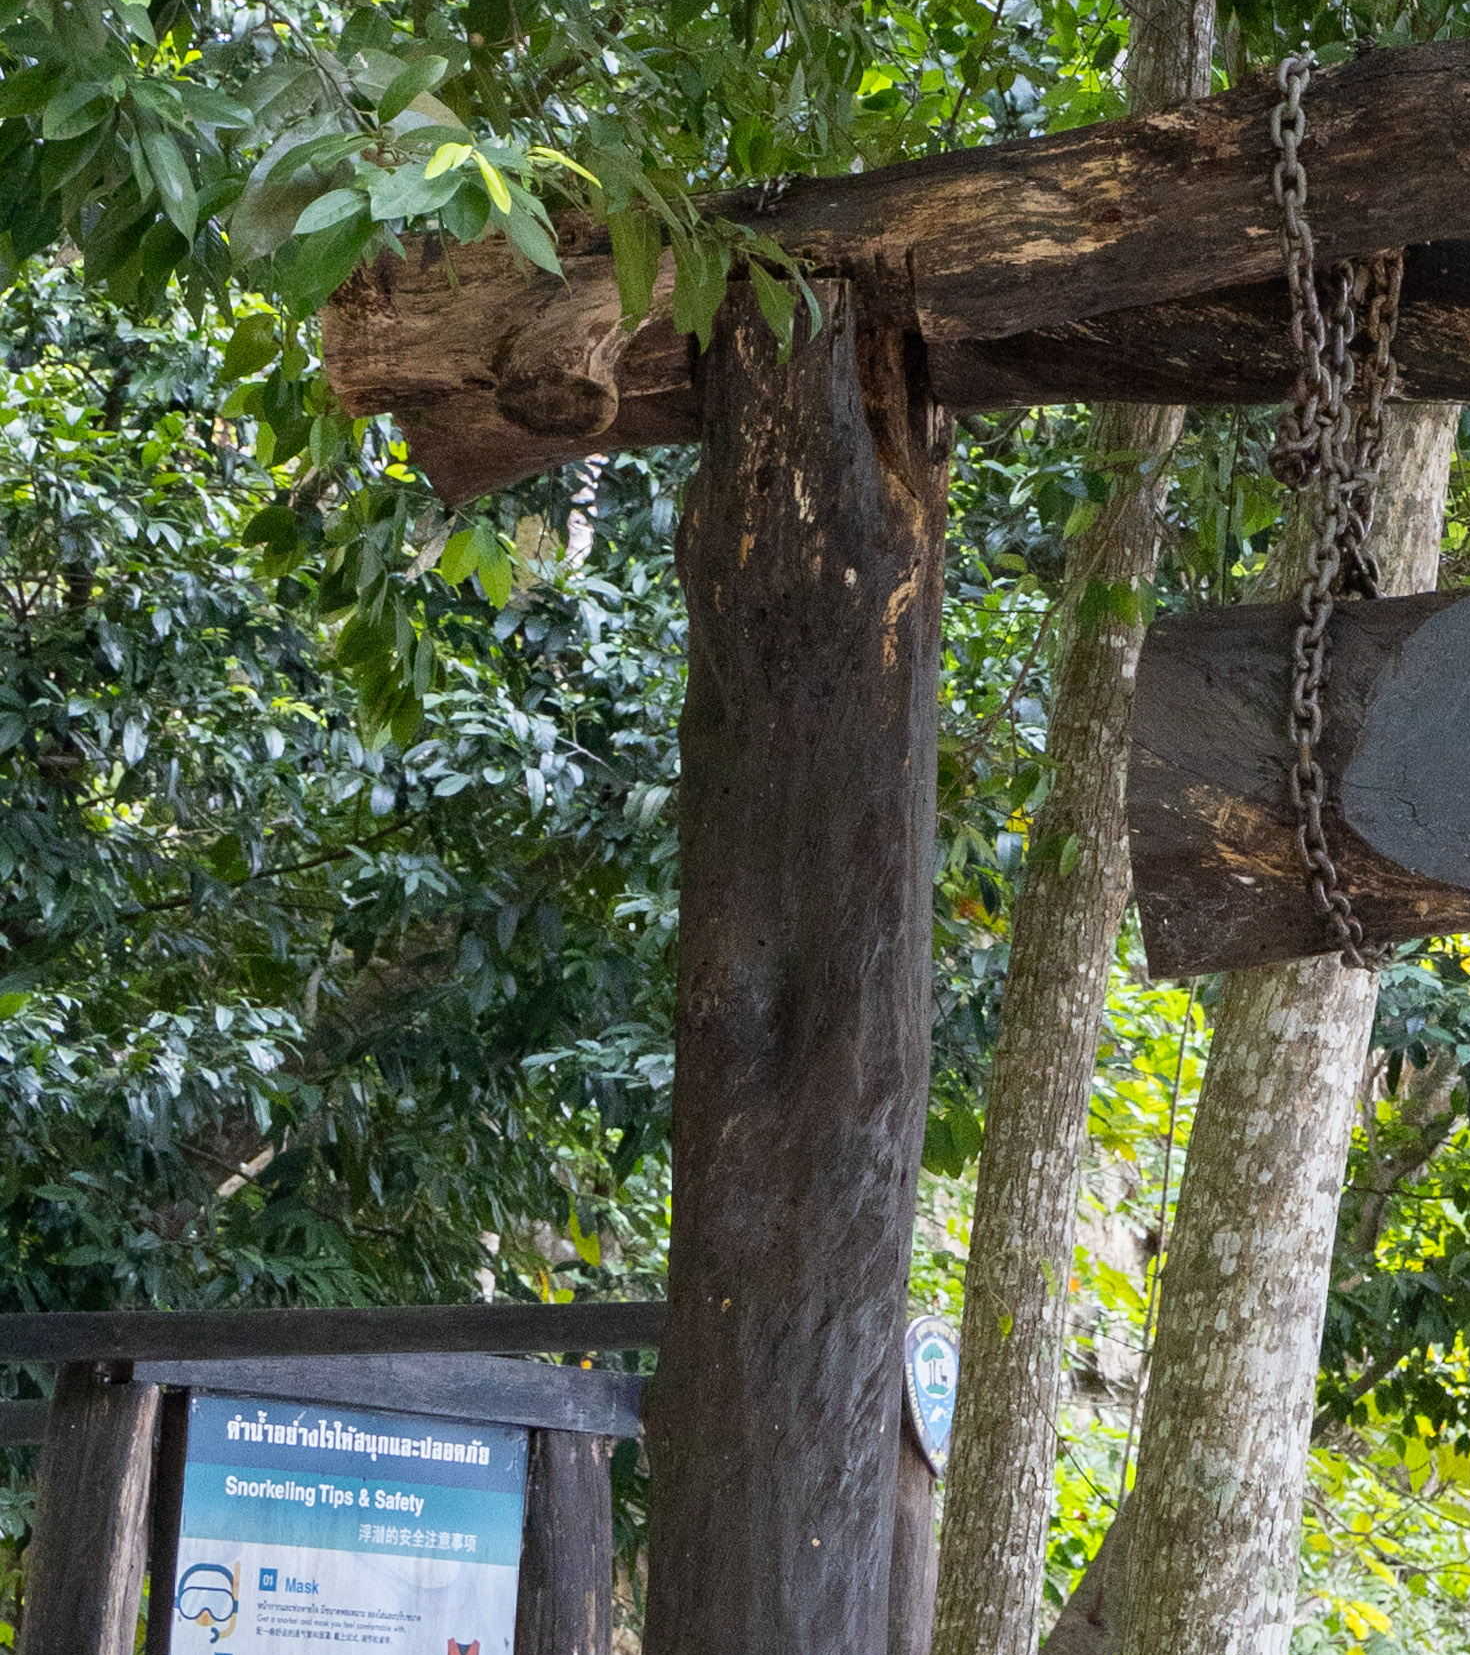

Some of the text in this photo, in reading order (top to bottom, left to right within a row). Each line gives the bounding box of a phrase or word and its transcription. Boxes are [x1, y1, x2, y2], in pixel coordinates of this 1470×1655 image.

[226, 1410, 491, 1466] ดำน้ำอย่างไรให้สนุกและปลอดภัย
[225, 1475, 425, 1517] Snorkeling Tips & Safety
[262, 1574, 320, 1595] 01 Mask
[300, 1617, 312, 1626] and
[331, 1621, 342, 1630] you
